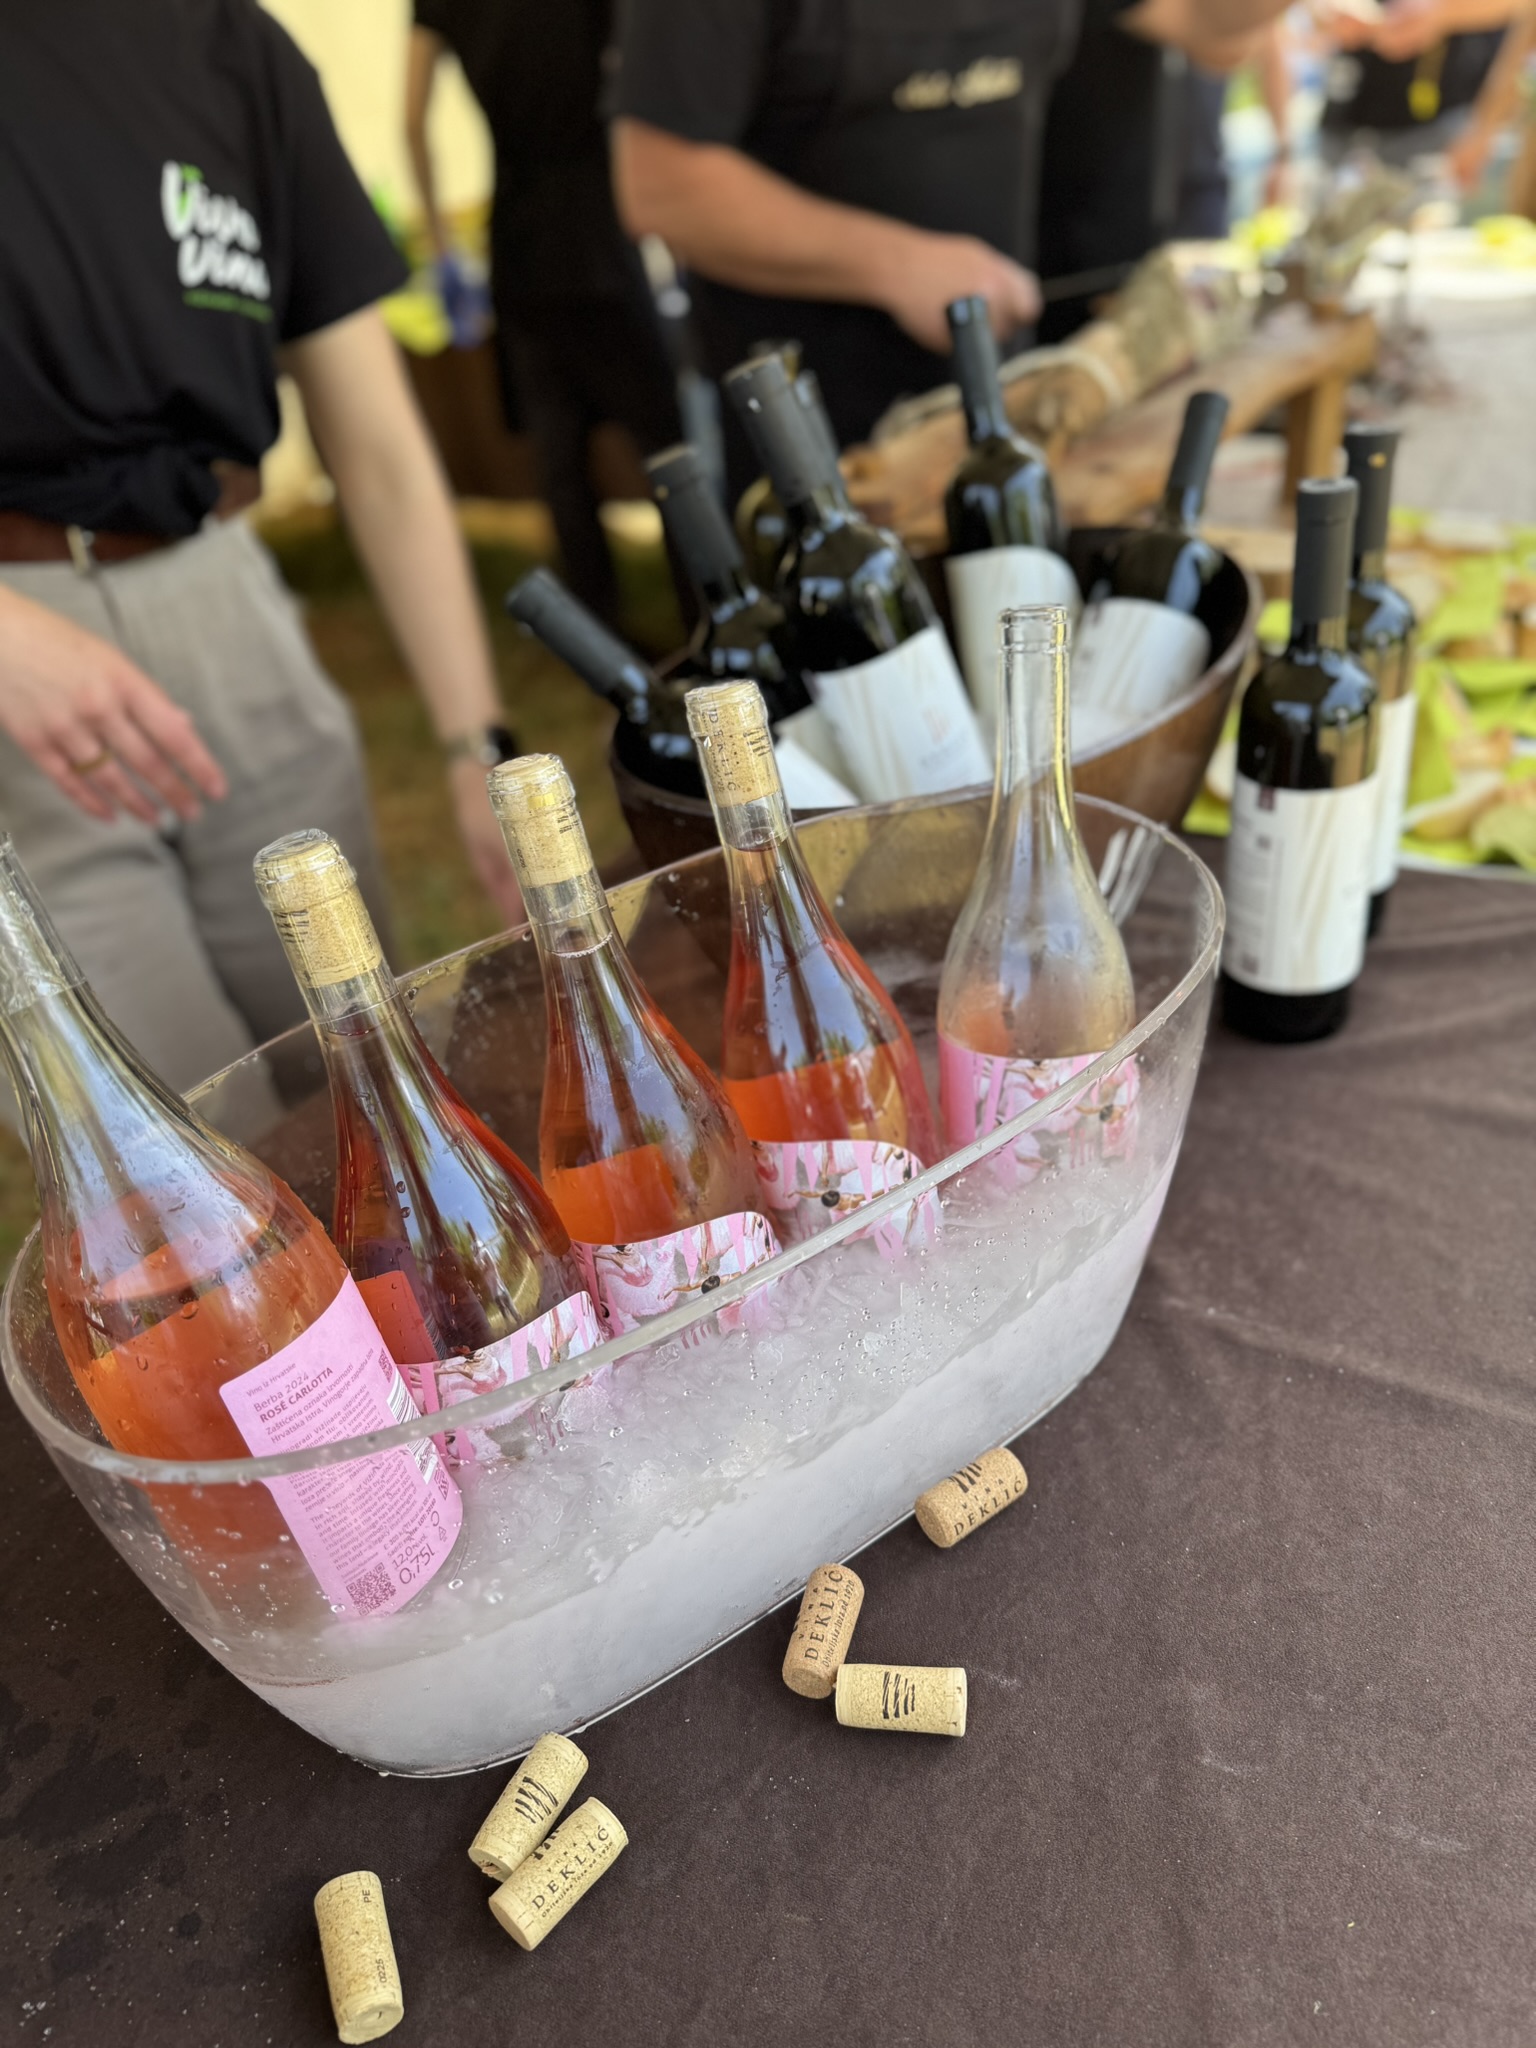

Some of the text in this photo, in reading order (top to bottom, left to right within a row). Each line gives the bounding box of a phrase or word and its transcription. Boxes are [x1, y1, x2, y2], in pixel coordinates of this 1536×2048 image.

[254, 1372, 309, 1412] Berba 2024
[259, 1367, 333, 1423] ROSÉ CARLOTTA
[266, 1364, 354, 1435] Zaštićena oznaka izvornosti
[271, 1419, 305, 1444] Hrvatska
[322, 1379, 351, 1409] Vinogorje
[954, 1475, 1021, 1536] DEKLIĆ
[348, 1551, 363, 1563] land
[804, 1570, 843, 1661] DEKLIĆ
[362, 1889, 372, 1903] PE
[532, 1825, 608, 1909] DEKLIĆ
